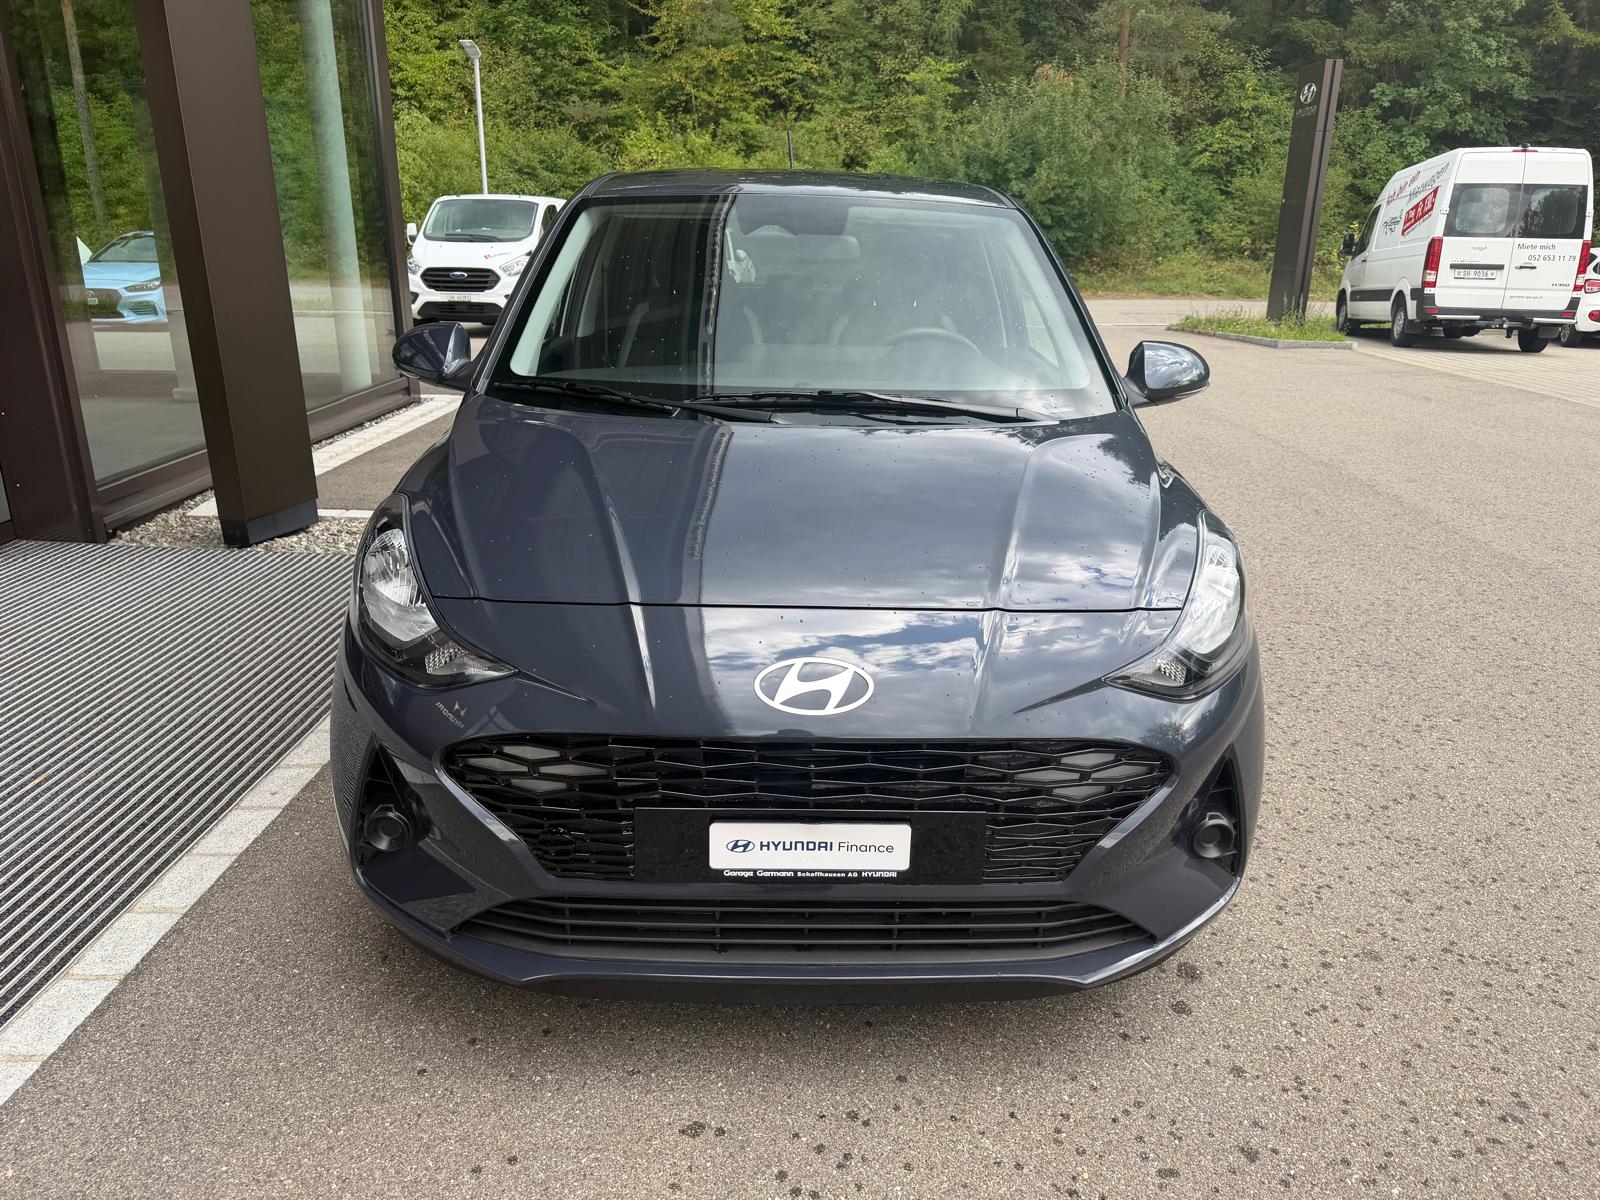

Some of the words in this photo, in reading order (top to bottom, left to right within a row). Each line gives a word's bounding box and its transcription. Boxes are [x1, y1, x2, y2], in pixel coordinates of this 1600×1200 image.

[1527, 254, 1541, 262] 052
[1542, 254, 1556, 262] 653
[759, 840, 833, 852] HYUNDAI
[837, 841, 895, 853] Finance
[723, 869, 754, 878] Garage
[756, 869, 794, 877] Germann
